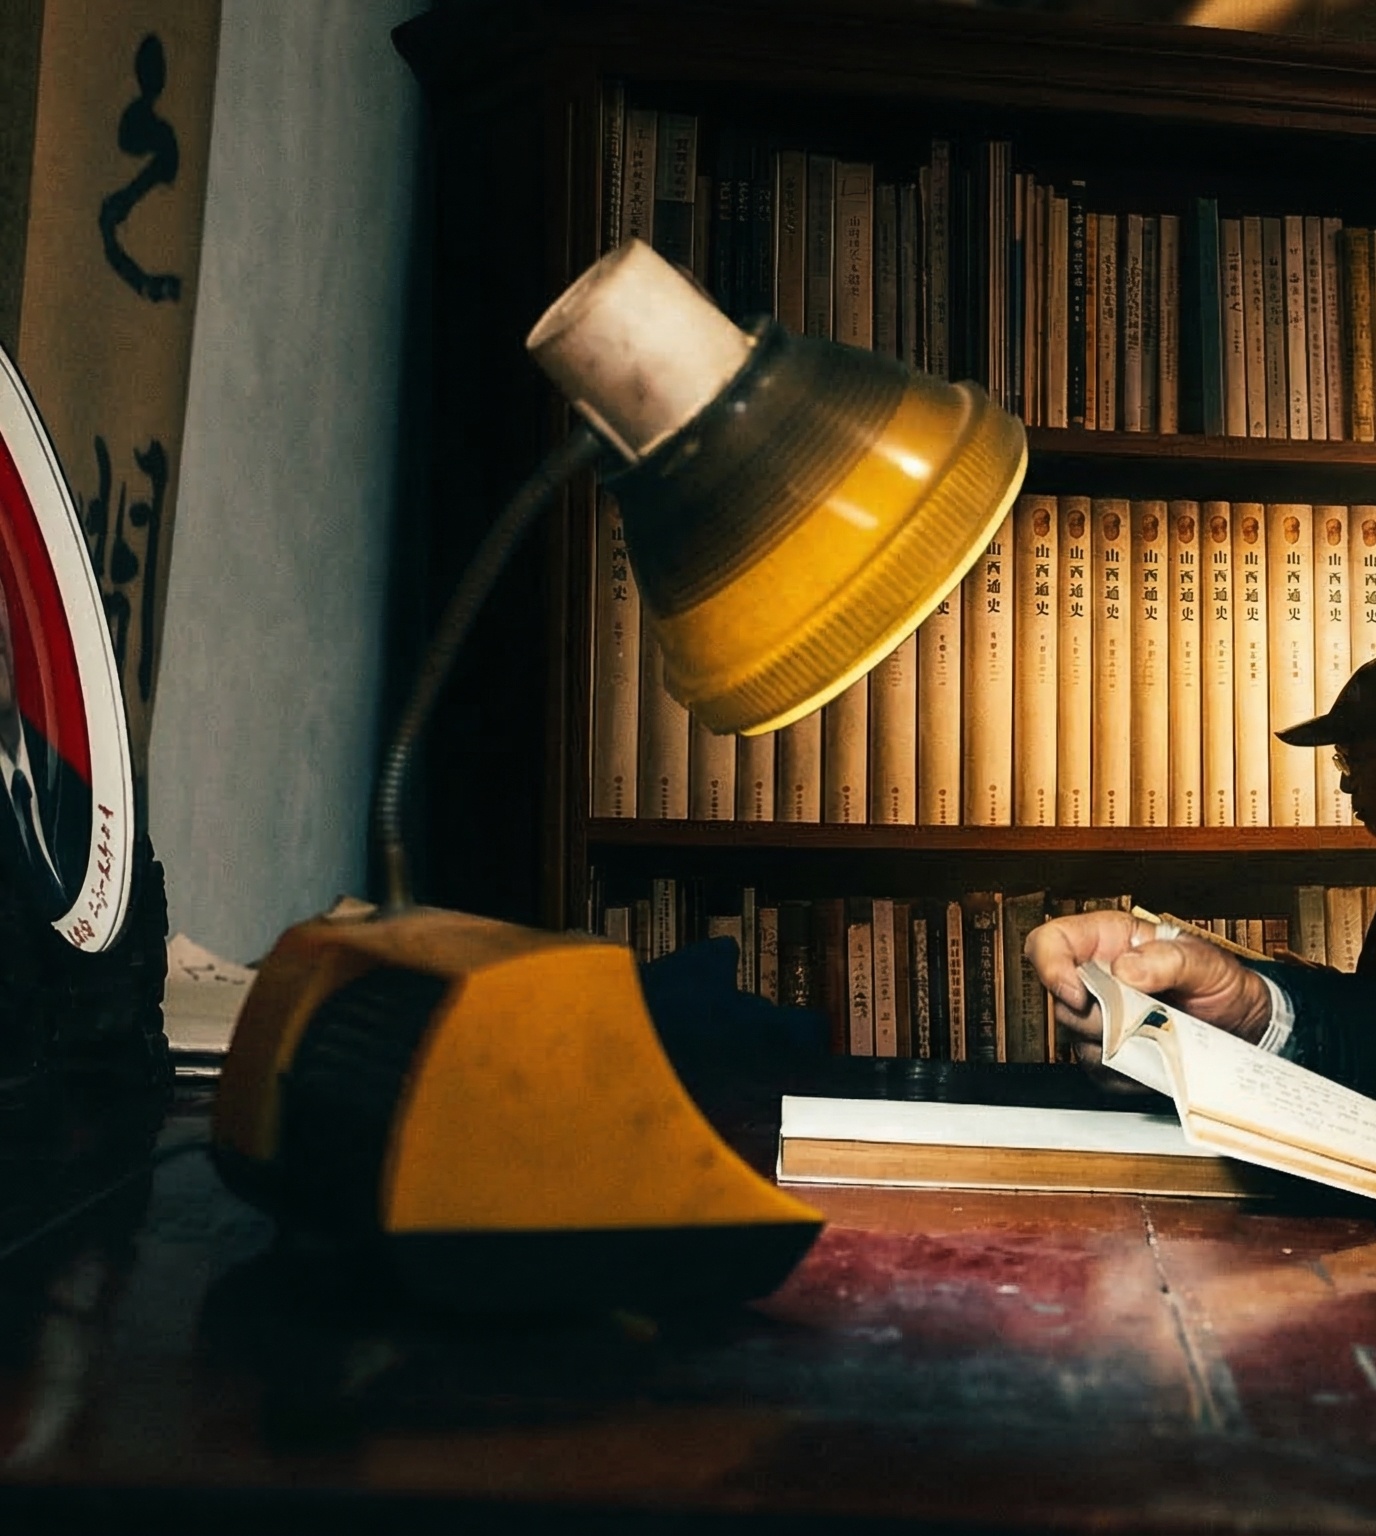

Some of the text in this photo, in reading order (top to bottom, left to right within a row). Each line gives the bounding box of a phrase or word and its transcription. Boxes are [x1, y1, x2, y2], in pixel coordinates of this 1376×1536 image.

[986, 541, 1001, 614] 山西通史
[1035, 543, 1050, 616] 山西通史
[1069, 545, 1084, 618] 山西通史
[1104, 548, 1120, 620] 山西通史
[1143, 549, 1158, 621] 山西通史
[1179, 550, 1195, 622] 山西通史
[1213, 549, 1228, 621] 山西通史
[1243, 551, 1260, 622] 山西通史
[1286, 551, 1301, 622] 山西通史
[1328, 553, 1342, 622] 山西通史
